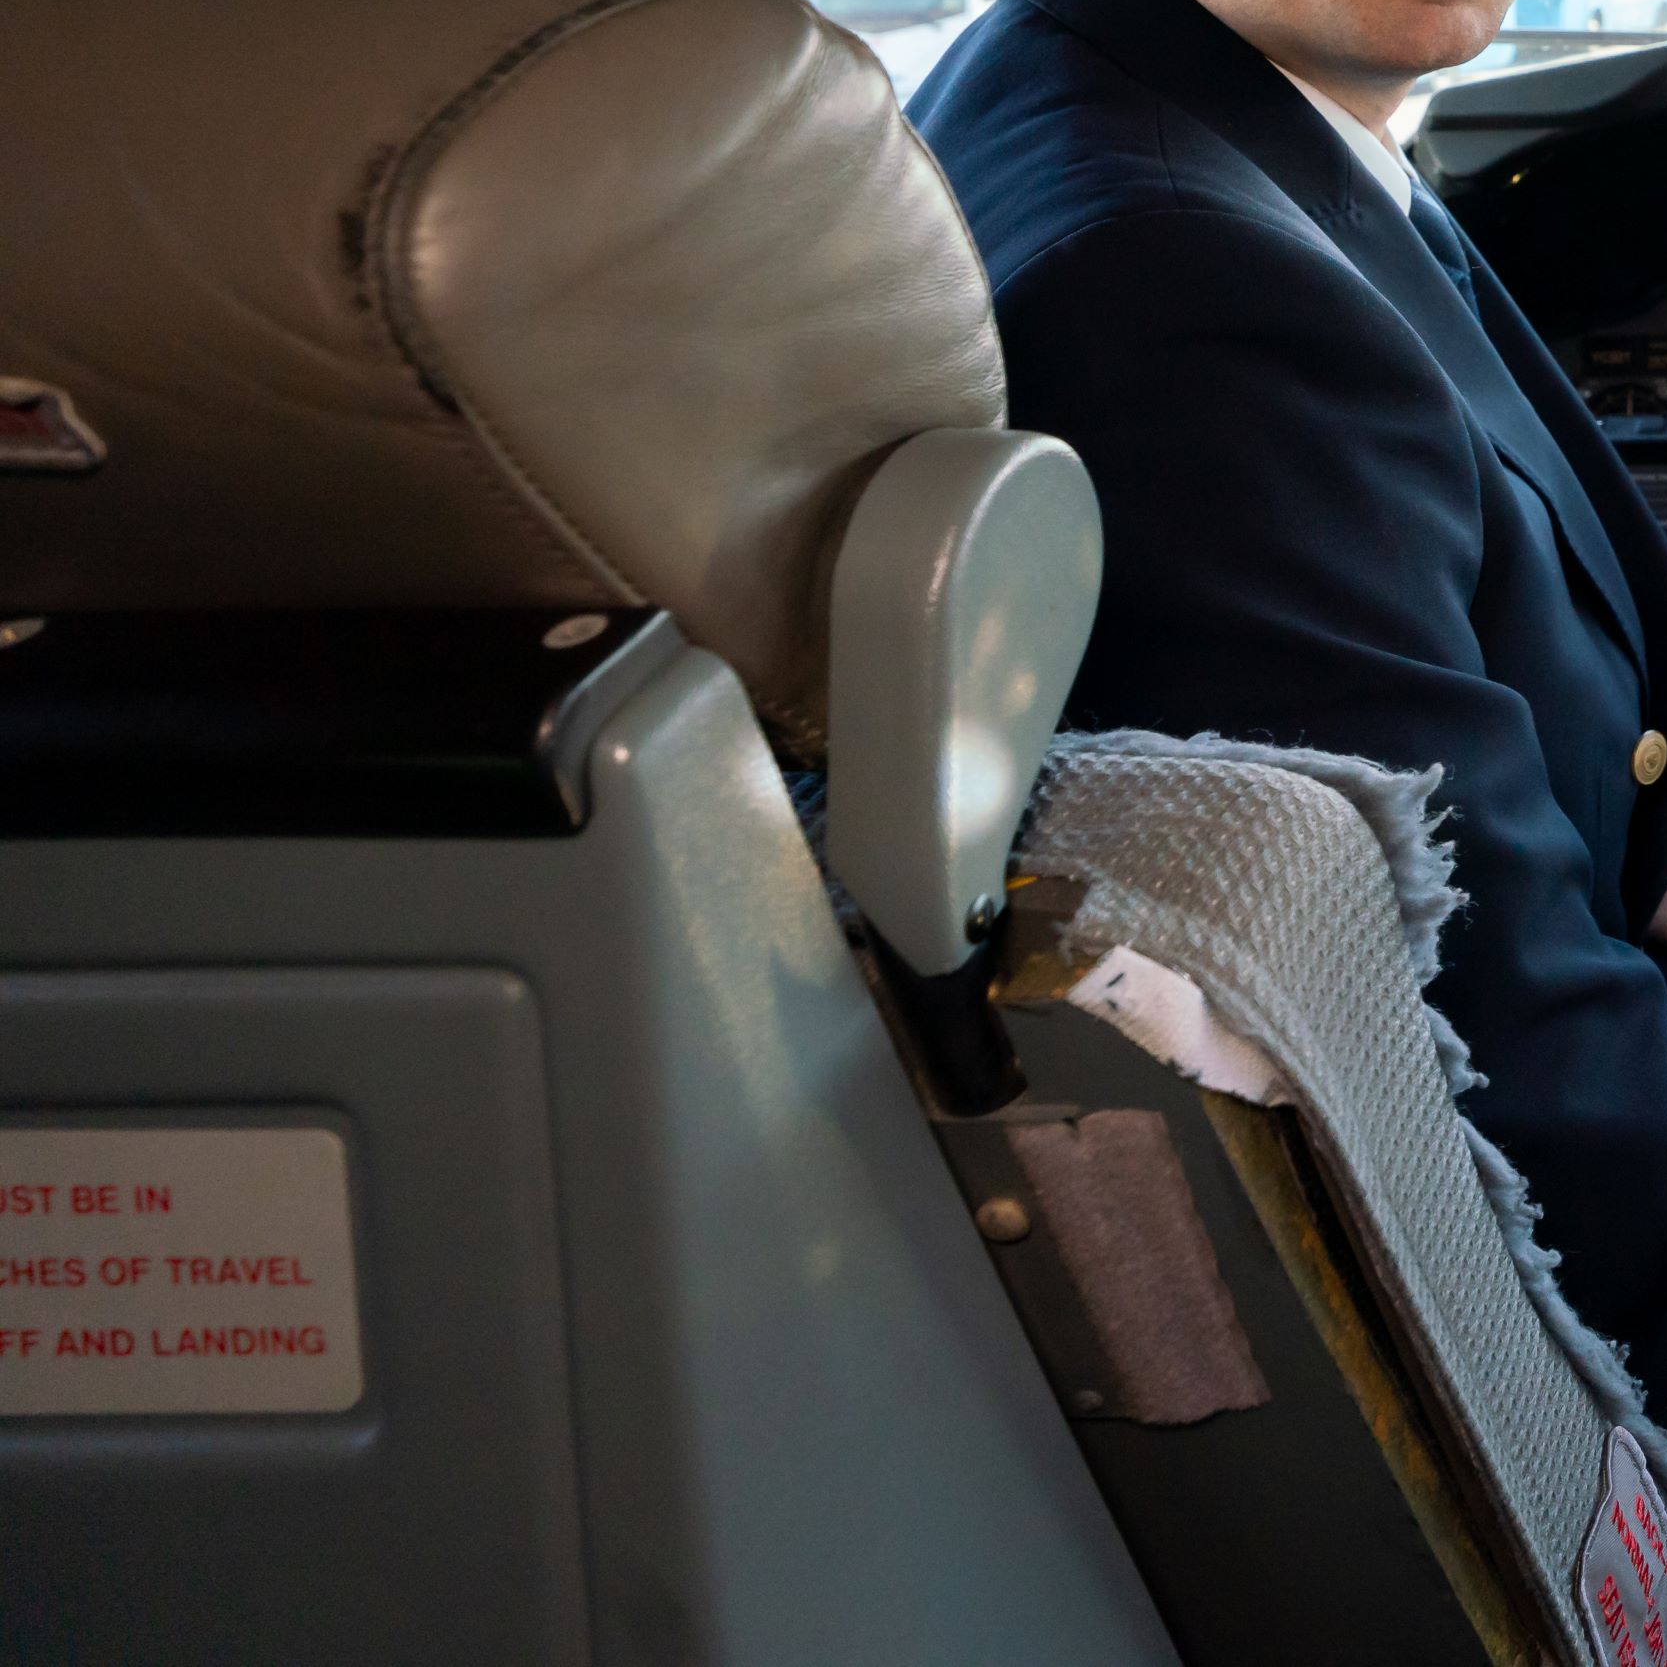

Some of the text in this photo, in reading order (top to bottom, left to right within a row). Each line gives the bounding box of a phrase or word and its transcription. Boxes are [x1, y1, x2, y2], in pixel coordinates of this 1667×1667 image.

[70, 1184, 119, 1215] BE
[134, 1184, 173, 1214] IN
[100, 1257, 151, 1286] OF
[166, 1256, 315, 1286] TRAVEL
[56, 1327, 135, 1358] AND
[152, 1325, 326, 1357] LANDING
